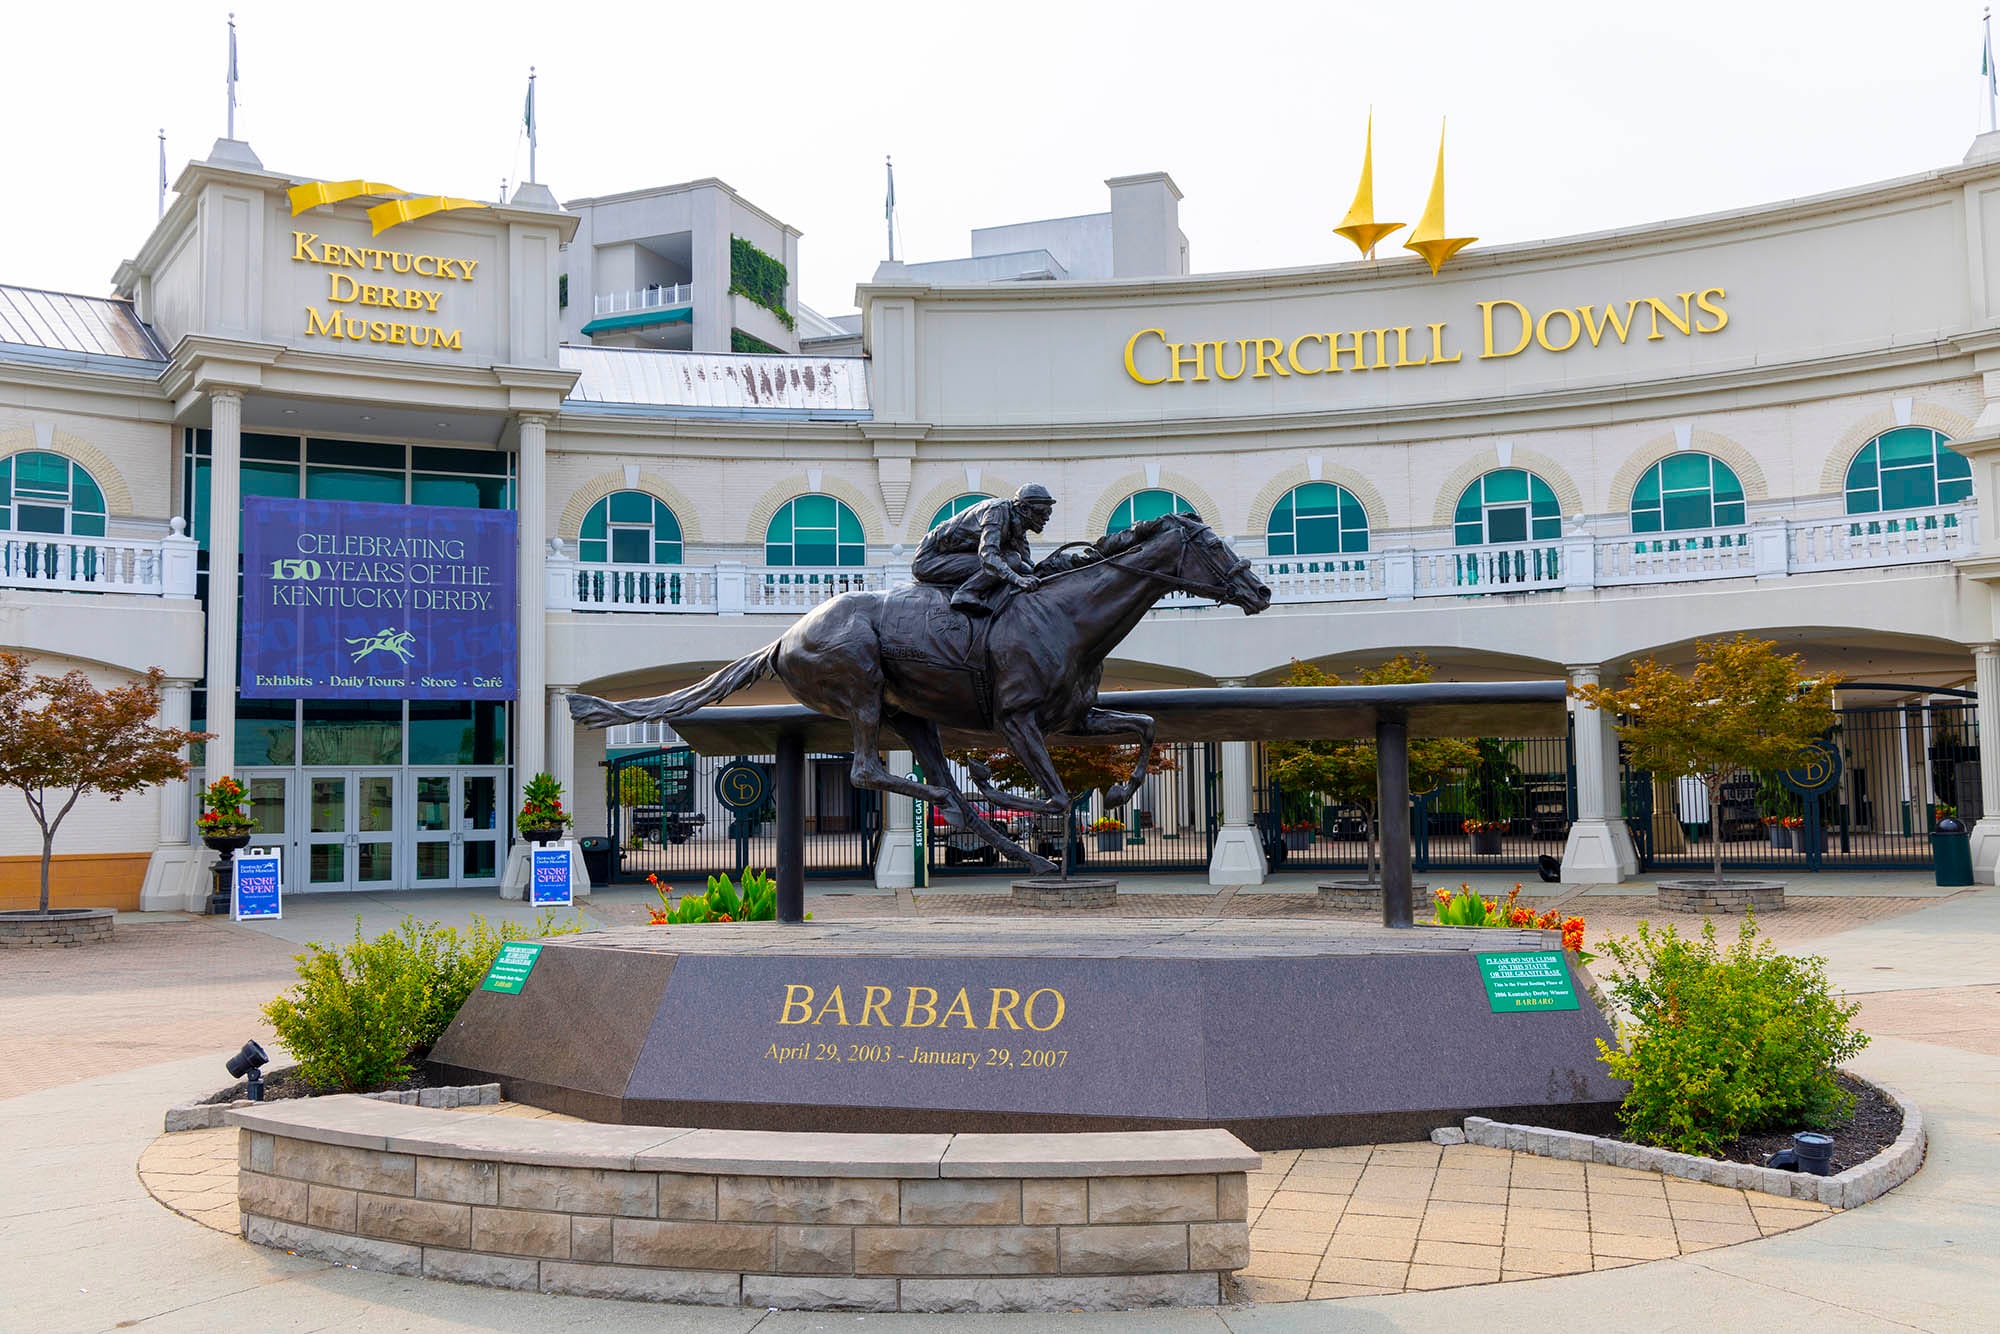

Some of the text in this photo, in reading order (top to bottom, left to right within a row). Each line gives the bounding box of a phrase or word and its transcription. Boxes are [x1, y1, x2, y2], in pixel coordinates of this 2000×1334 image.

[291, 231, 479, 281] KENTUCKY
[327, 272, 443, 312] DERBY
[304, 305, 463, 350] MUSEUM
[1123, 287, 1730, 387] CHURCHILL DOWNS
[296, 533, 465, 560] CELEBRATING
[270, 559, 491, 586] 150 YEARS OF THE
[273, 585, 492, 611] KENTUCKY DERBY
[255, 674, 503, 688] Exhibits Daily Tours Store Café
[915, 798, 923, 847] SERVICE GAT
[241, 877, 276, 885] STORE
[537, 867, 567, 875] STORE
[242, 885, 275, 894] OPEN!
[776, 983, 1066, 1032] BARBARO
[1515, 998, 1554, 1006] BARBARO
[764, 1042, 810, 1065] April
[815, 1043, 841, 1064] 29,
[847, 1045, 891, 1063] 2003
[909, 1046, 980, 1070] January
[985, 1048, 1014, 1069] 29,
[1020, 1049, 1069, 1069] 2007
